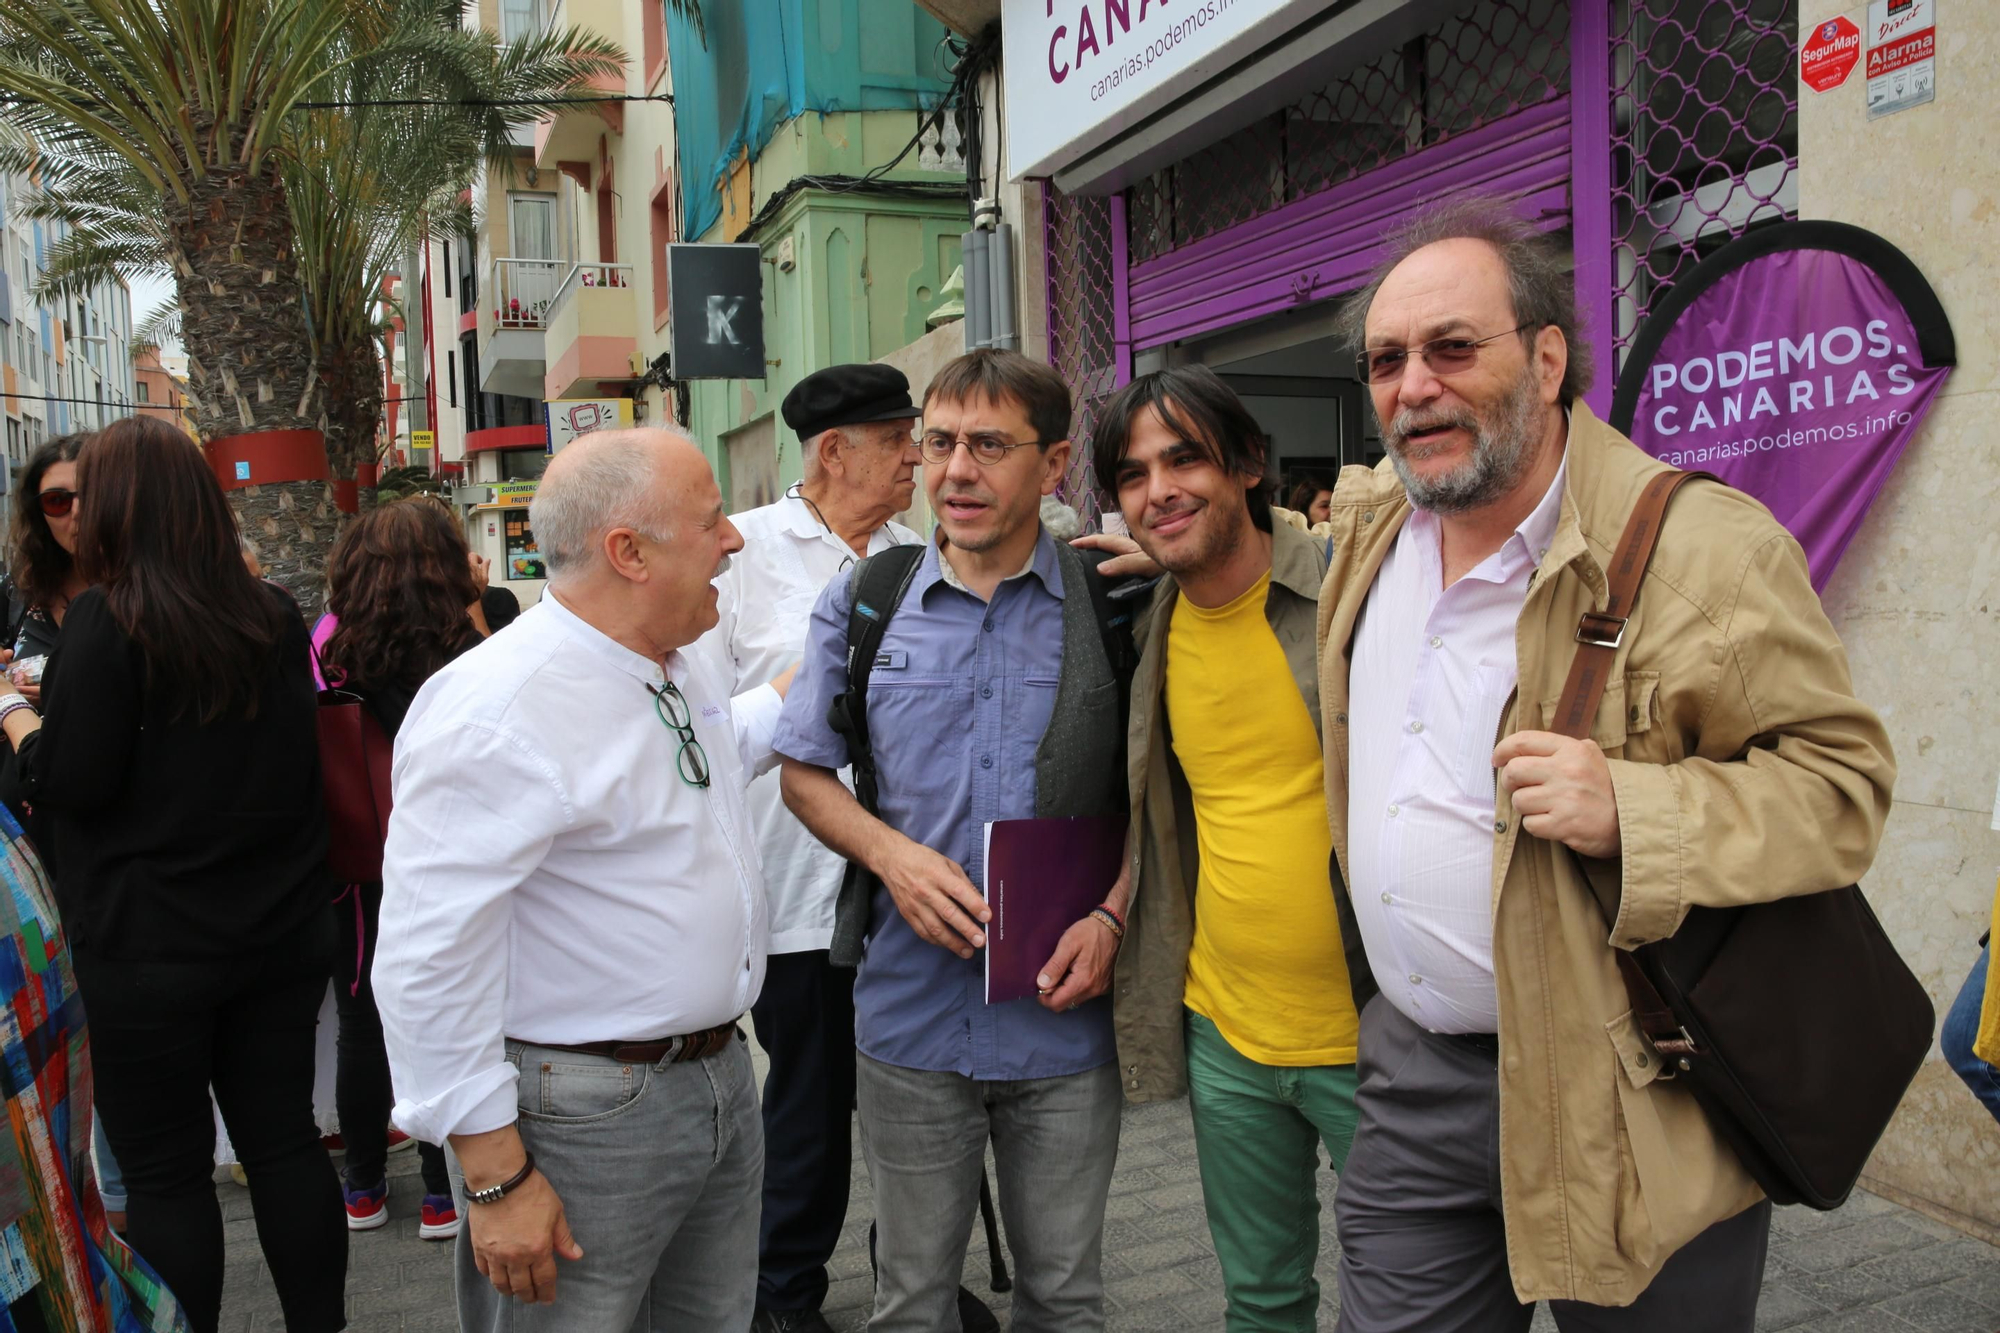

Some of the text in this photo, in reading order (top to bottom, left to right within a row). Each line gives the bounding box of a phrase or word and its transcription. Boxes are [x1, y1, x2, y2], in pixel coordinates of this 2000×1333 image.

[1802, 33, 1859, 64] SegurMap
[1868, 35, 1933, 69] Alarma
[1868, 67, 1881, 76] con
[1882, 60, 1901, 71] Aviso
[706, 295, 744, 344] K
[1653, 319, 1908, 399] PODEMOS.
[1654, 364, 1915, 436] CANARIAS
[501, 485, 539, 493] SUPERMERC
[511, 496, 533, 504] FRUTER
